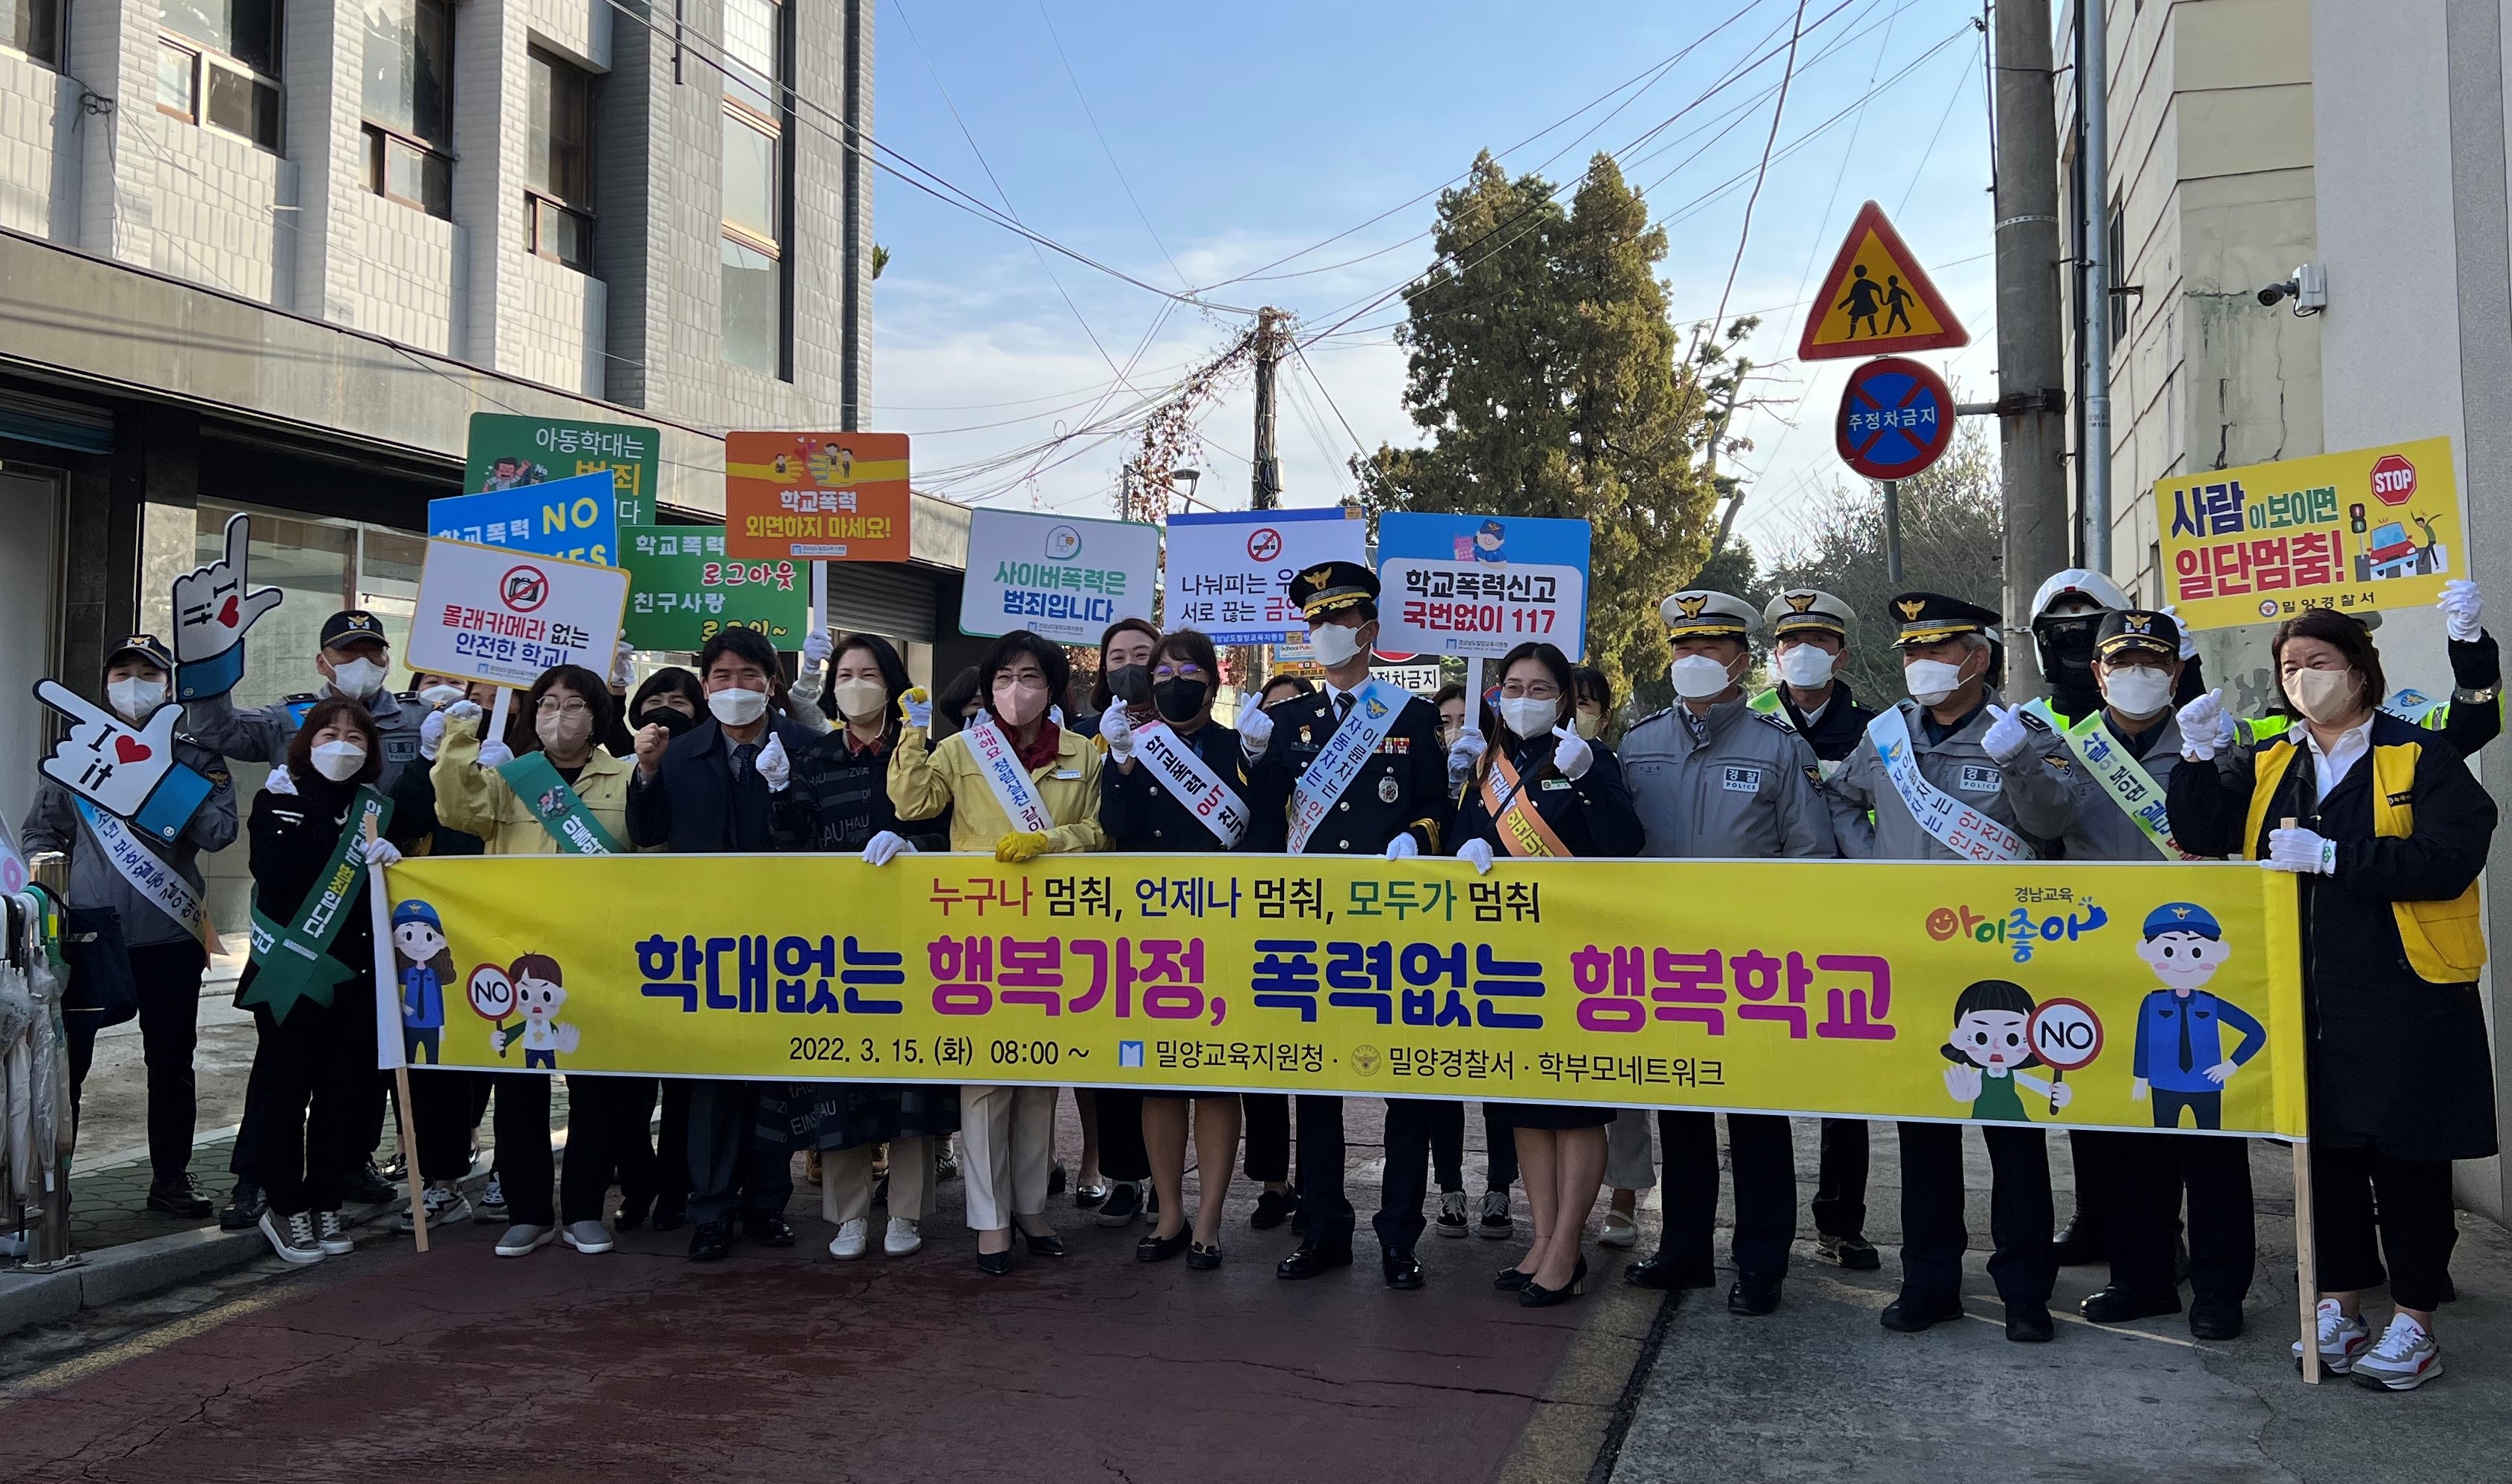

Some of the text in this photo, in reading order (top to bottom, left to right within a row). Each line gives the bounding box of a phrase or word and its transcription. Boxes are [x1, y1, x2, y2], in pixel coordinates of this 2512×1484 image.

[1848, 406, 1935, 432] 주정차금지
[536, 428, 645, 459] 아동학대는
[2375, 468, 2412, 494] STOP
[543, 497, 598, 535] NO
[780, 490, 857, 513] 학교폭력
[745, 515, 891, 539] 외면하지 마세요!
[545, 544, 607, 566] ES
[636, 535, 725, 556] 학교폭력
[701, 561, 796, 592] 로그아웃
[994, 561, 1126, 595] 사이버폭력은
[2175, 530, 2345, 600] 일단멈춤!
[213, 578, 238, 599] I
[1182, 568, 1305, 596] 나눠피는 우
[1406, 569, 1556, 603] 학교폭력신고
[184, 602, 213, 626] it
[634, 592, 725, 614] 친구사랑
[1004, 590, 1114, 623] 범죄입니다
[1181, 602, 1215, 623] 서로
[1221, 601, 1256, 623] 끊는
[1403, 600, 1556, 633] 국번없이 117
[442, 604, 589, 650] 몰래카메라 없는
[456, 632, 516, 662] 안전한
[1371, 669, 1436, 689] 차금지
[87, 723, 117, 752] I
[1306, 715, 1363, 787] 자동차는
[79, 758, 113, 791] it
[1145, 735, 1208, 795] 학교폭력
[1197, 784, 1225, 816] OUT
[1321, 728, 1379, 799] 이륜차는
[992, 757, 1031, 807] 청렴실천
[2109, 766, 2148, 803] 보이면
[1894, 767, 1943, 833] 자동차는
[1959, 810, 2020, 856] 안전모
[929, 877, 1542, 925] 누구나 멈춰, 언제나 멈춰, 모두가 멈춰
[2015, 887, 2074, 904] 경남교육
[1926, 898, 2109, 963] 아이좋아
[474, 981, 510, 1004] NO
[635, 934, 1897, 1040] 학대없는 행복가정, 폭력없는 행복학교
[789, 1037, 851, 1063] 2022.
[860, 1038, 880, 1064] 3.
[893, 1039, 925, 1064] 15.
[934, 1036, 973, 1067] (화)
[990, 1040, 1059, 1065] 08:00
[2041, 1020, 2094, 1051] NO
[1156, 1040, 1324, 1072] 밀양교육지원청
[1389, 1046, 1514, 1080] 밀양경찰서
[1539, 1051, 1725, 1087] 학부모네트워크
